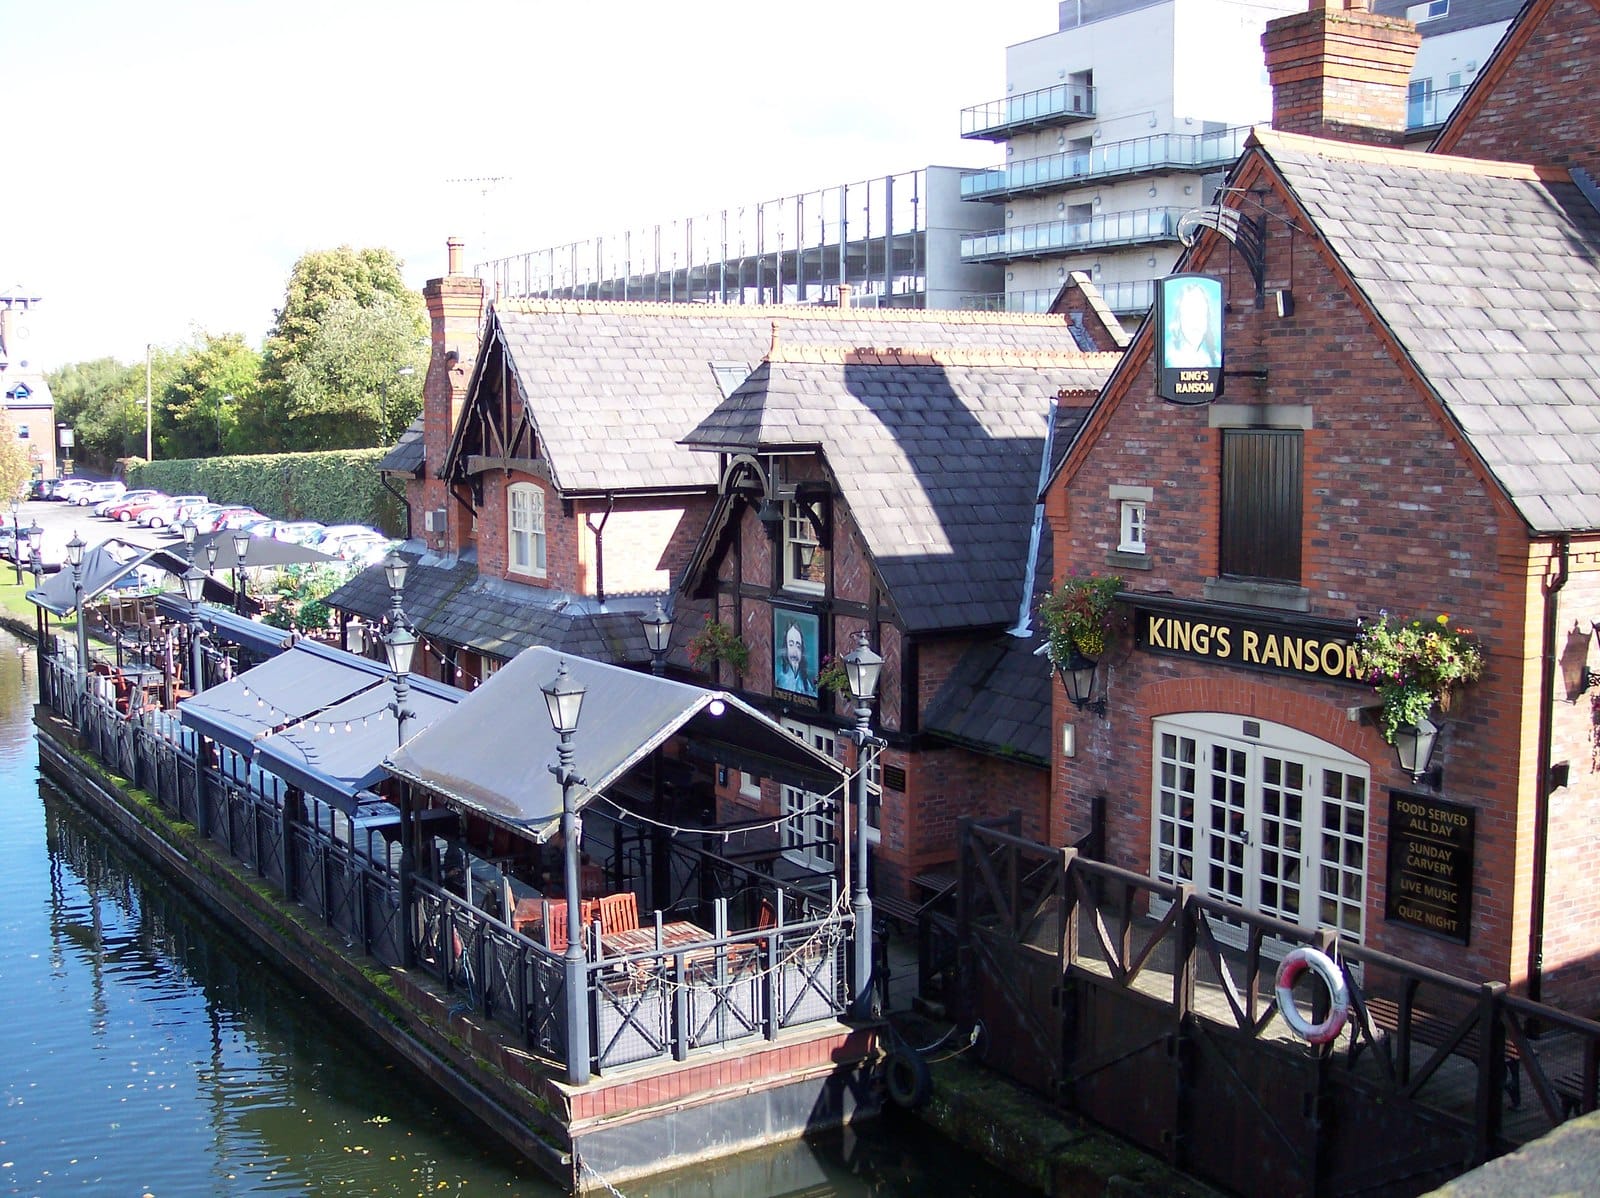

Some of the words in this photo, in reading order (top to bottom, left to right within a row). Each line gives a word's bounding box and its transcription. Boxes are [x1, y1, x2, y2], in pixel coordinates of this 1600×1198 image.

[1180, 371, 1208, 381] KING'S
[1175, 383, 1214, 393] RANSOM
[1149, 616, 1231, 658] KING'S
[1396, 800, 1426, 817] FOOD
[1428, 808, 1468, 827] SERVED
[1409, 818, 1429, 832] ALL
[1431, 823, 1453, 838] DAY
[1409, 842, 1452, 862] SUNDAY
[1406, 855, 1453, 876] CARVERY
[1400, 878, 1422, 894] LIVE
[1424, 884, 1458, 904] MUSIC
[1398, 904, 1423, 922] QUIZ
[1425, 913, 1458, 932] NIGHT
